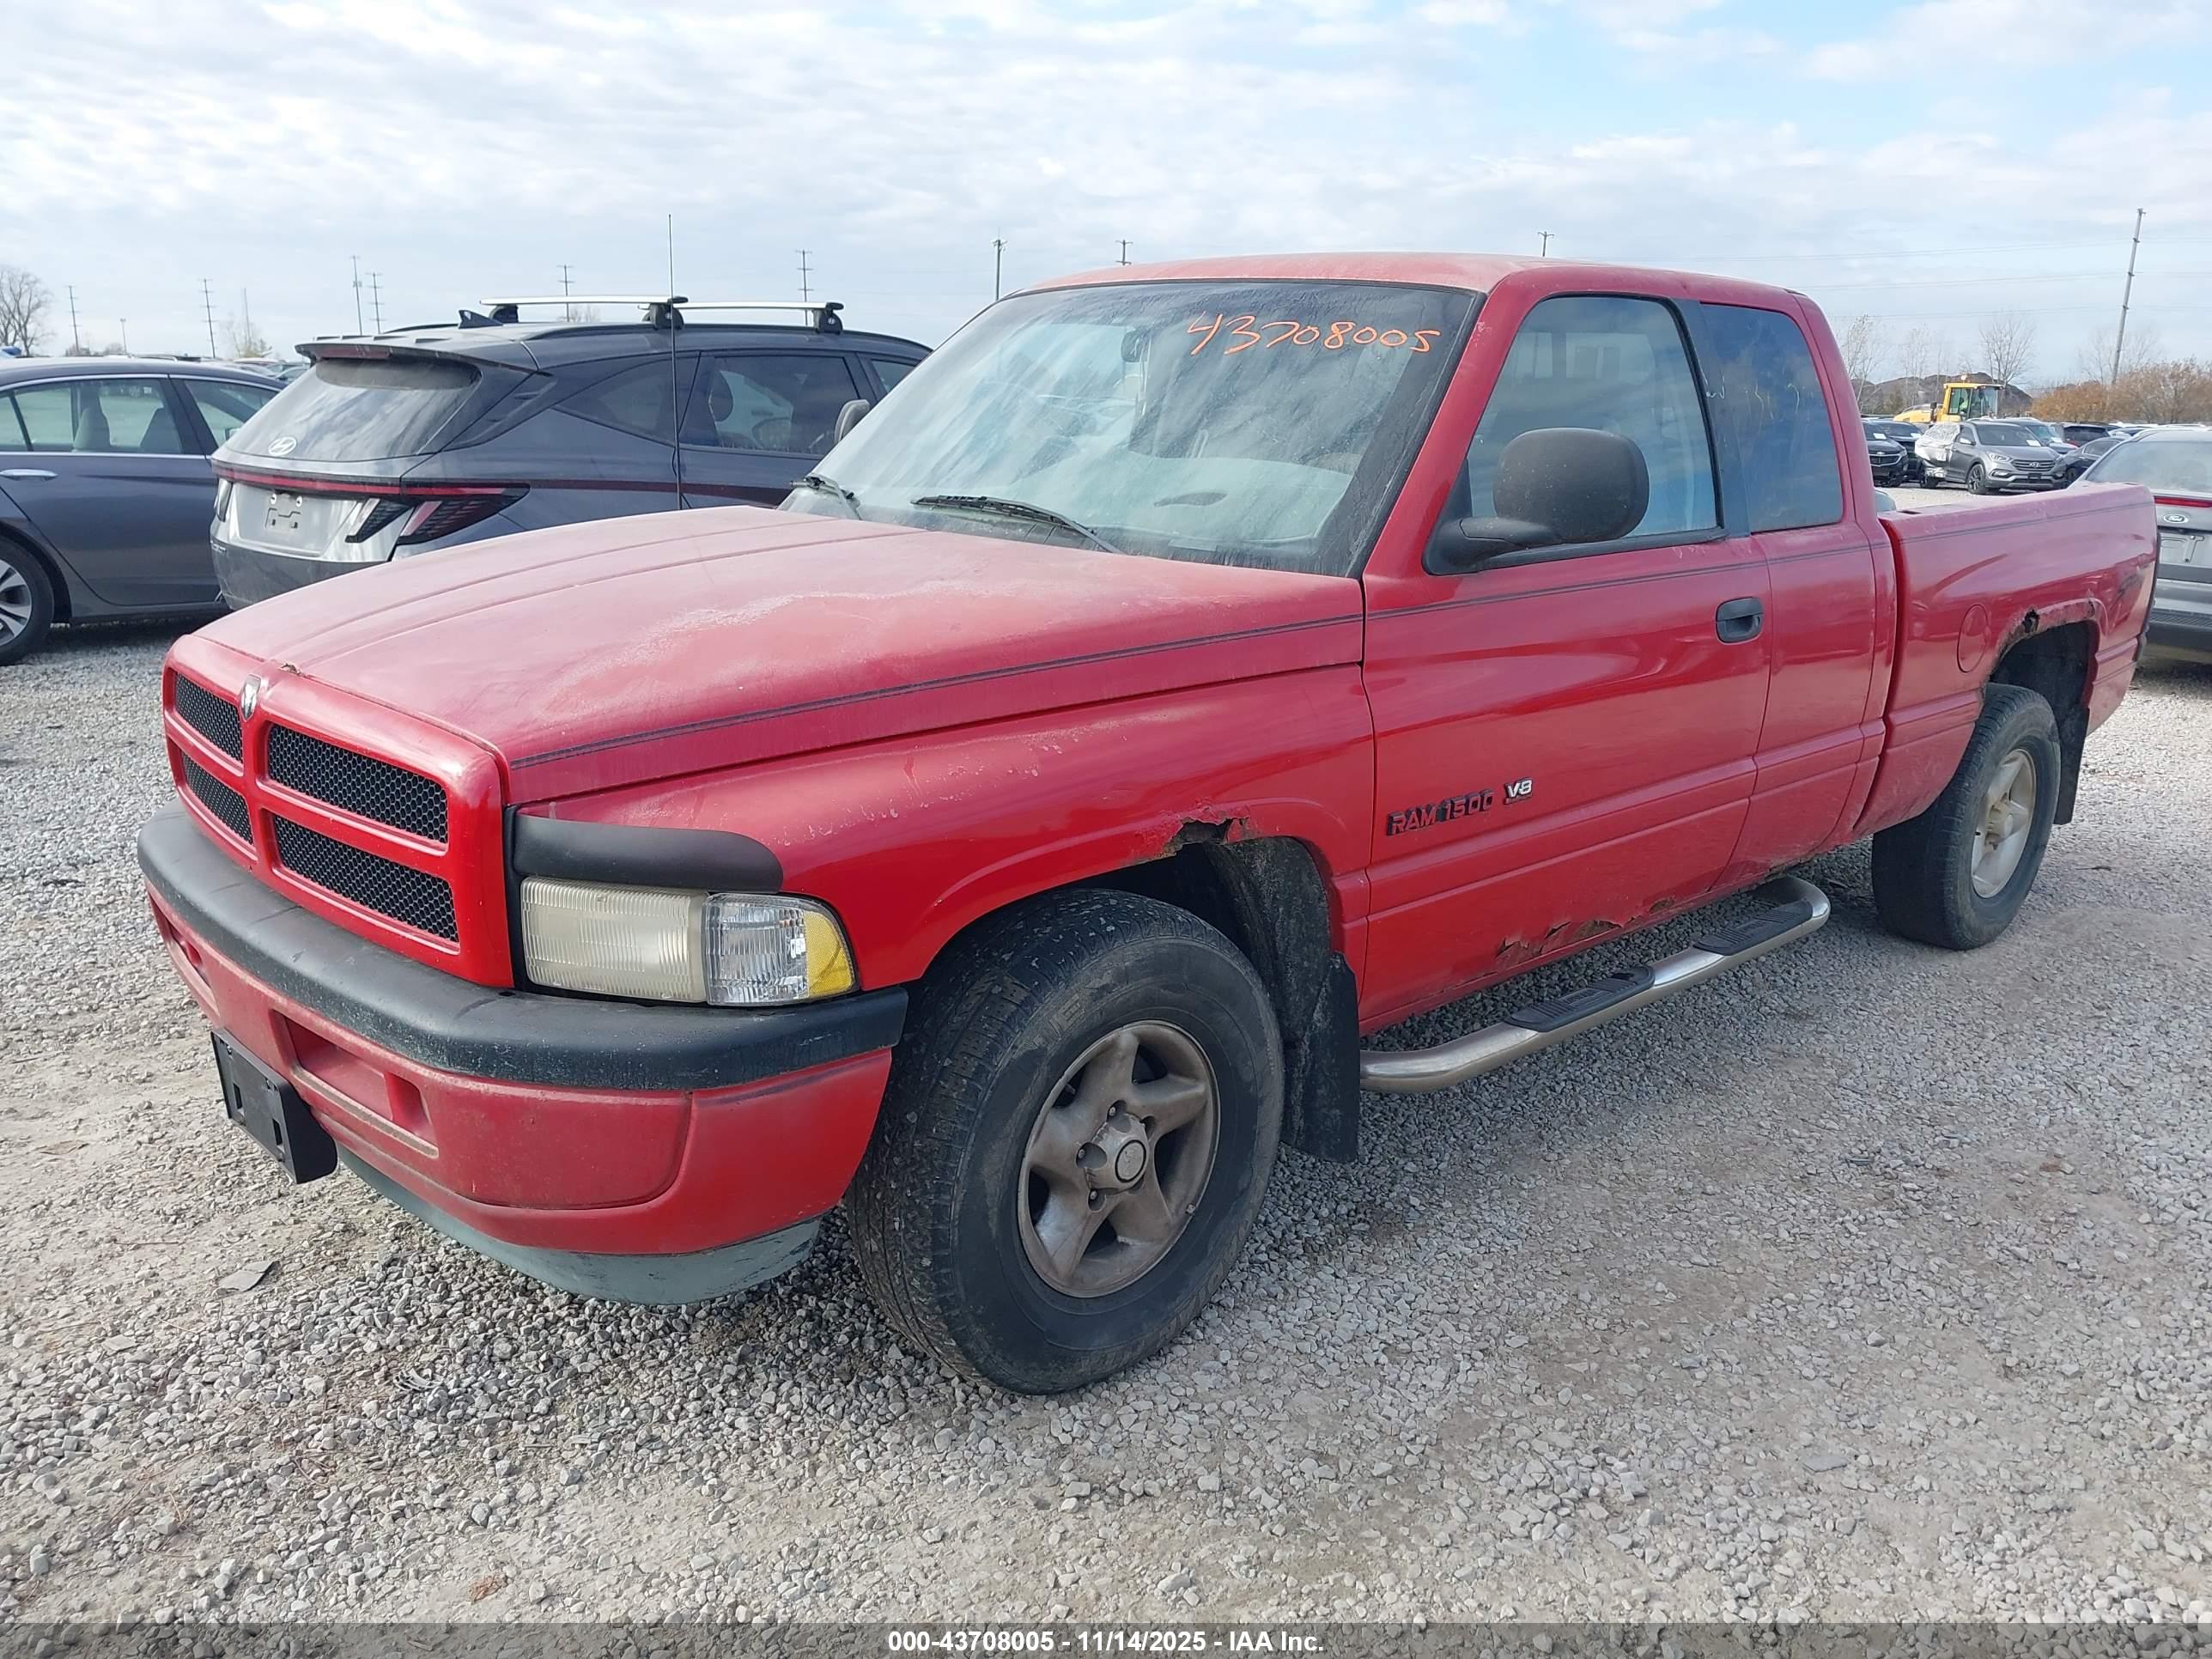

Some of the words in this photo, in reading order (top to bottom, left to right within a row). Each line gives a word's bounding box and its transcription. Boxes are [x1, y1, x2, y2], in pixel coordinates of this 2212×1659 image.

[1187, 312, 1441, 356] 43708005
[1386, 802, 1437, 836] RAM
[1442, 789, 1494, 821] 1500
[1504, 778, 1534, 802] V8
